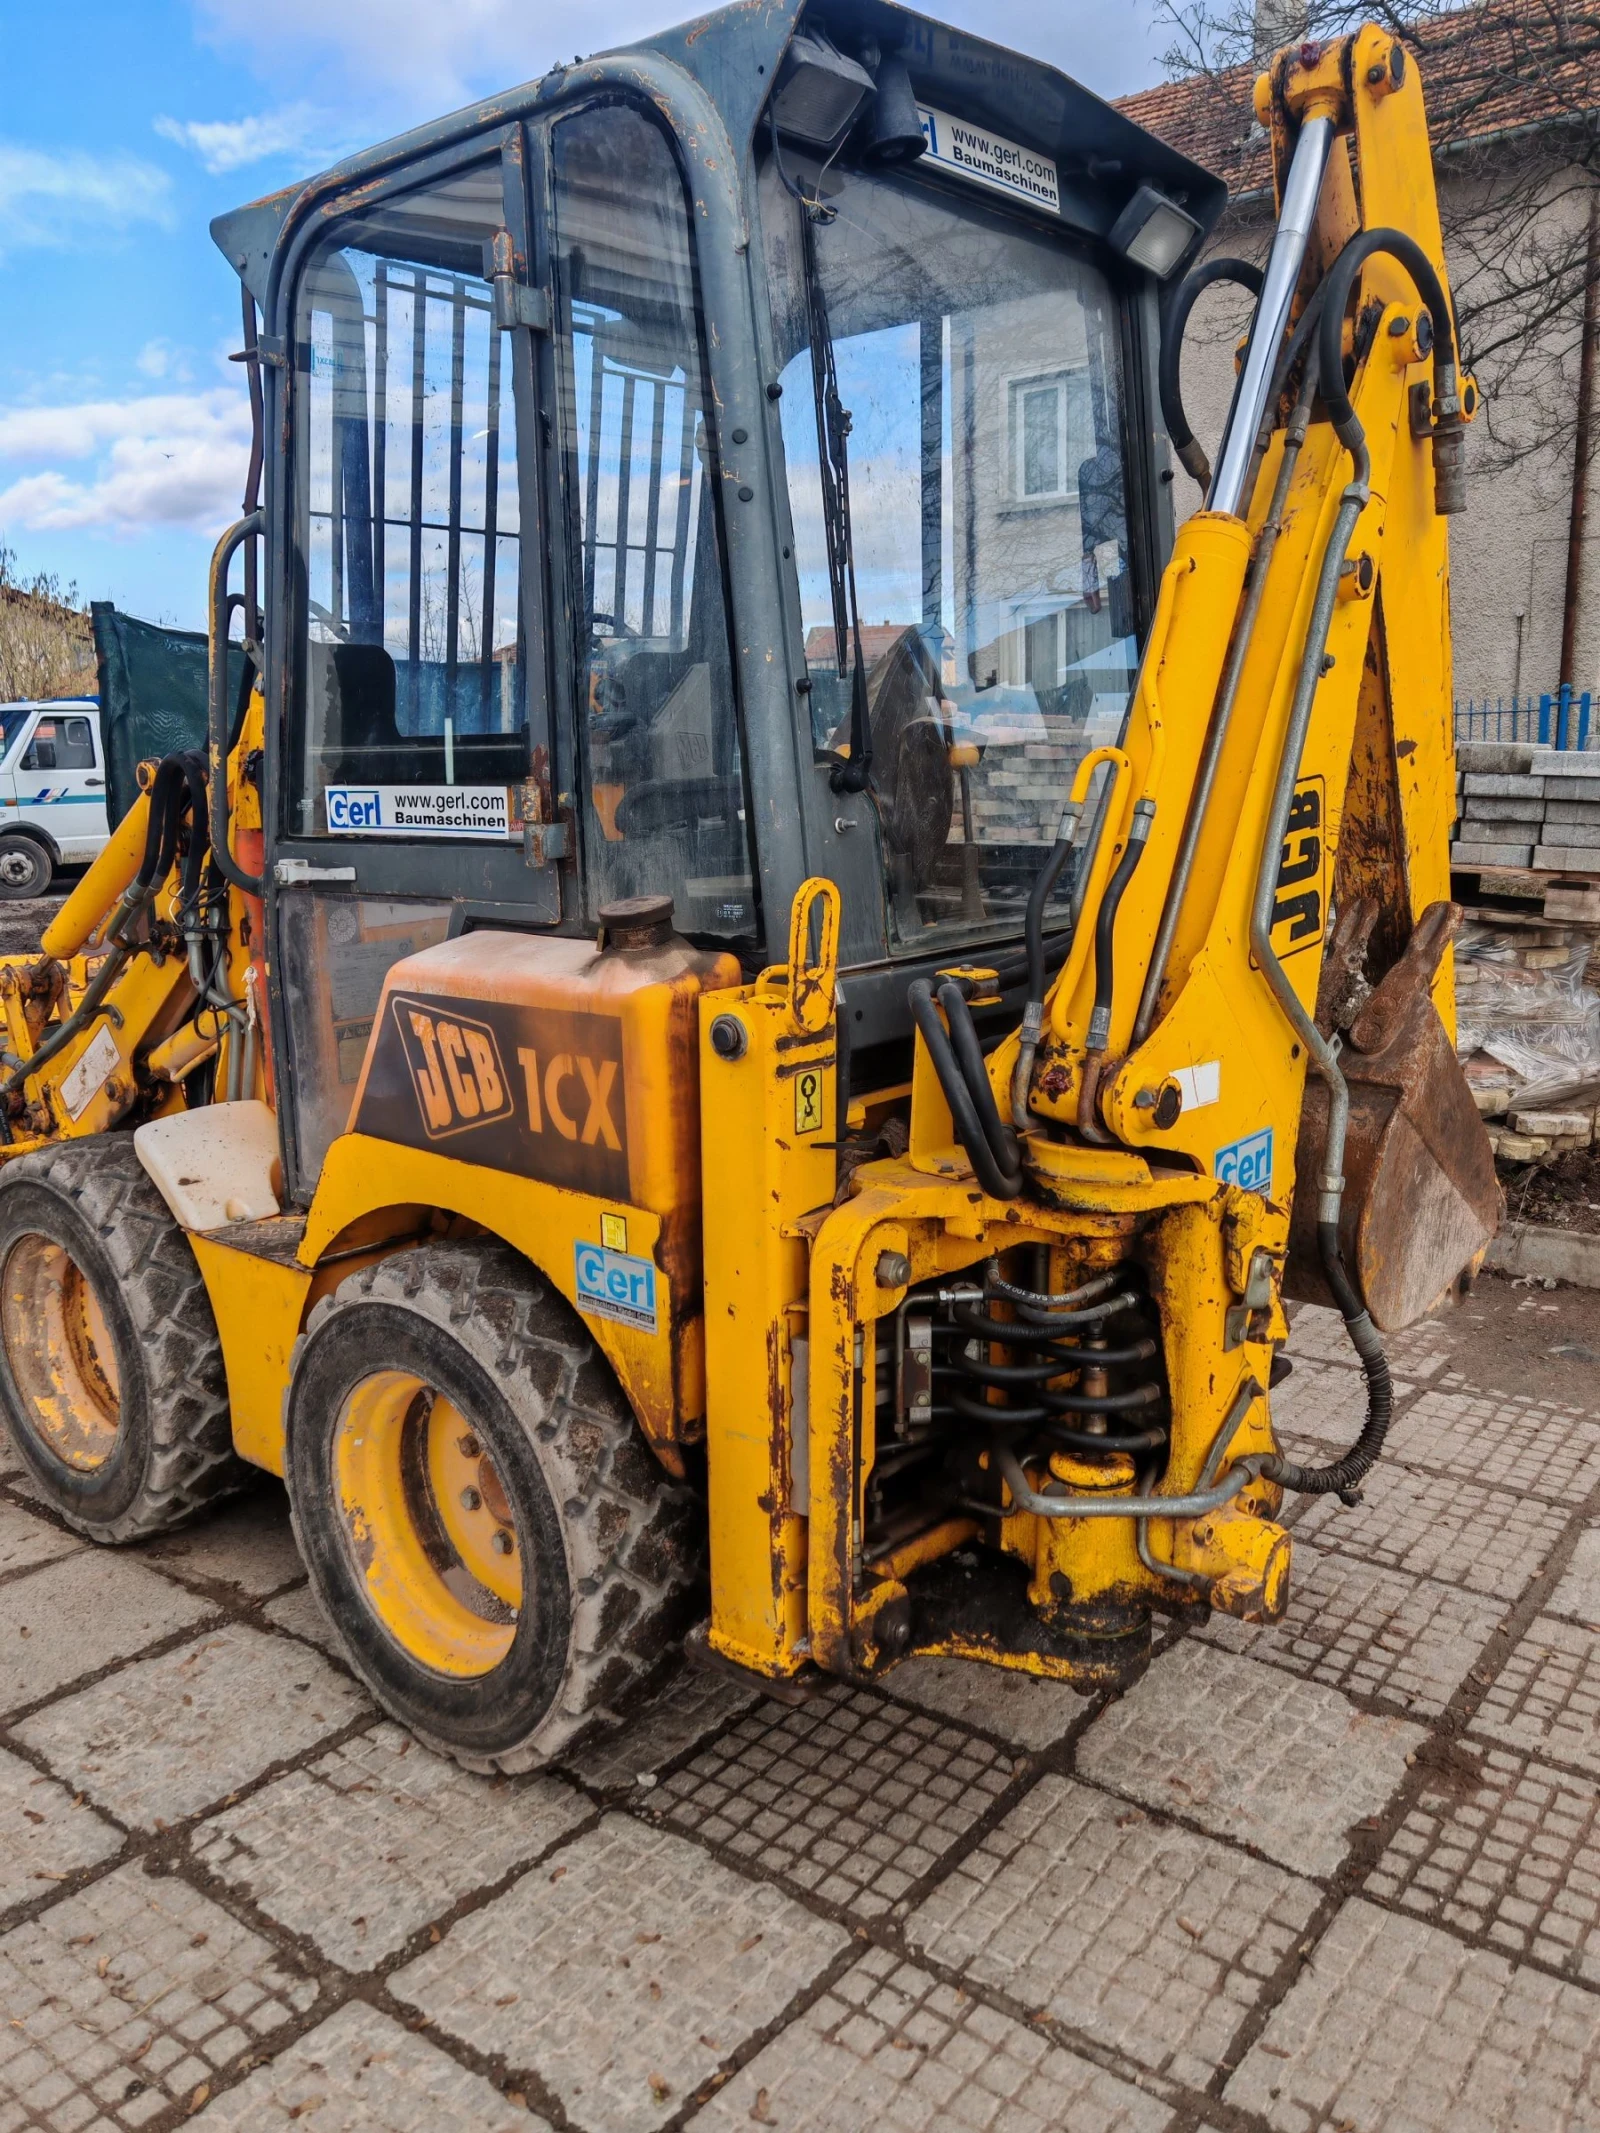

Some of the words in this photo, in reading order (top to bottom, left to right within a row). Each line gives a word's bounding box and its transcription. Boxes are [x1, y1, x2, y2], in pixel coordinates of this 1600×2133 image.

[951, 126, 1056, 184] www.gerl.com
[952, 145, 1057, 201] Baumaschinen
[330, 792, 382, 826] Gerl
[394, 792, 505, 813] www.gerl.com
[394, 811, 506, 828] Baumaschinen
[1268, 789, 1321, 943] JCB
[408, 1010, 504, 1130] JCB
[516, 1046, 623, 1152] 1CX
[577, 1247, 655, 1309] Gerl
